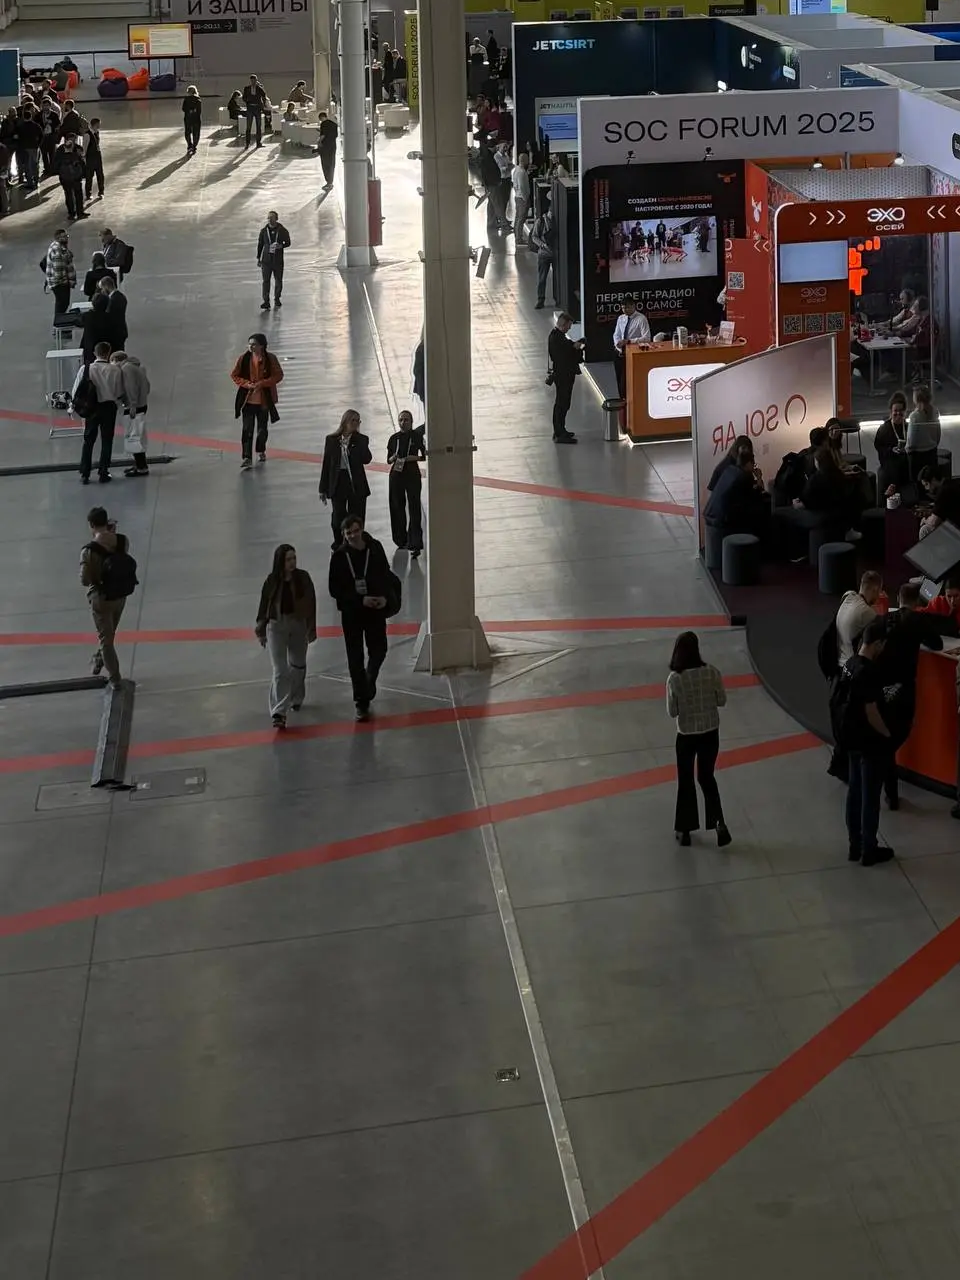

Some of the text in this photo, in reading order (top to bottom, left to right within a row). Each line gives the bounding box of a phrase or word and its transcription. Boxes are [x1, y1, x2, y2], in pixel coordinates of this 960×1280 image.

[187, 0, 202, 15] И
[604, 110, 876, 144] SOC FORUM 2025
[867, 207, 905, 223] ЭХО
[642, 288, 695, 300] IT-РАДИО!
[597, 304, 604, 313] И
[647, 299, 684, 310] САМОЕ
